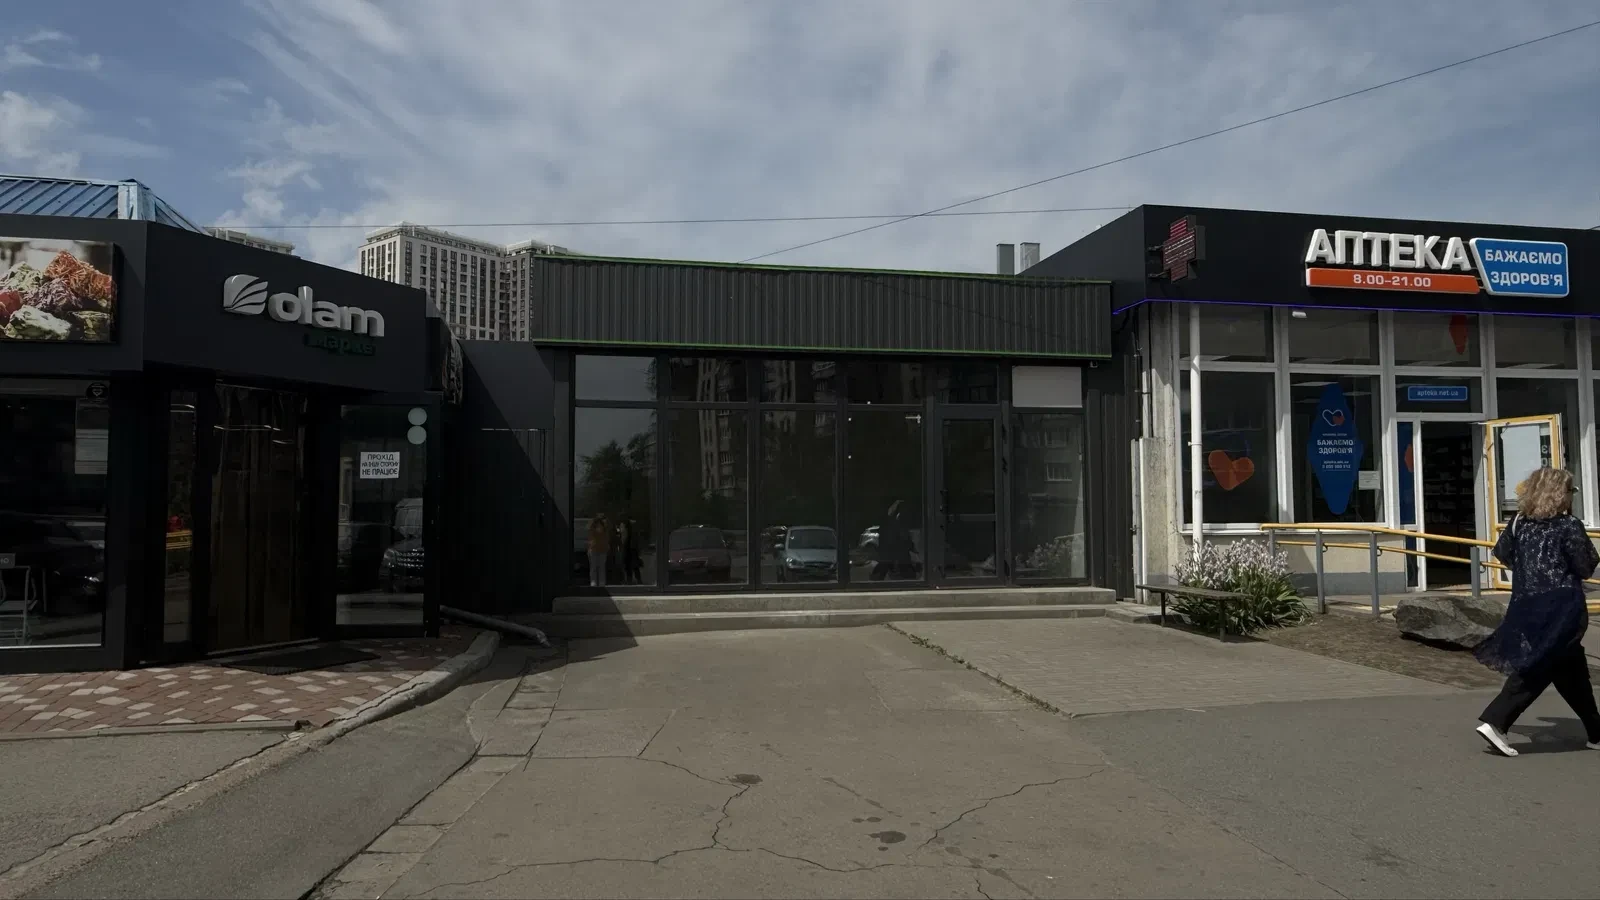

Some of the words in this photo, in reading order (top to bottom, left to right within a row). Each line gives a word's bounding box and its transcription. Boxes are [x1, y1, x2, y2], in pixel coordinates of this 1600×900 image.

[1305, 228, 1472, 271] АПТЕКА
[1484, 248, 1563, 265] БАЖАЄМО
[1490, 270, 1564, 287] ЗДОРОВ'Я
[268, 285, 385, 337] olam
